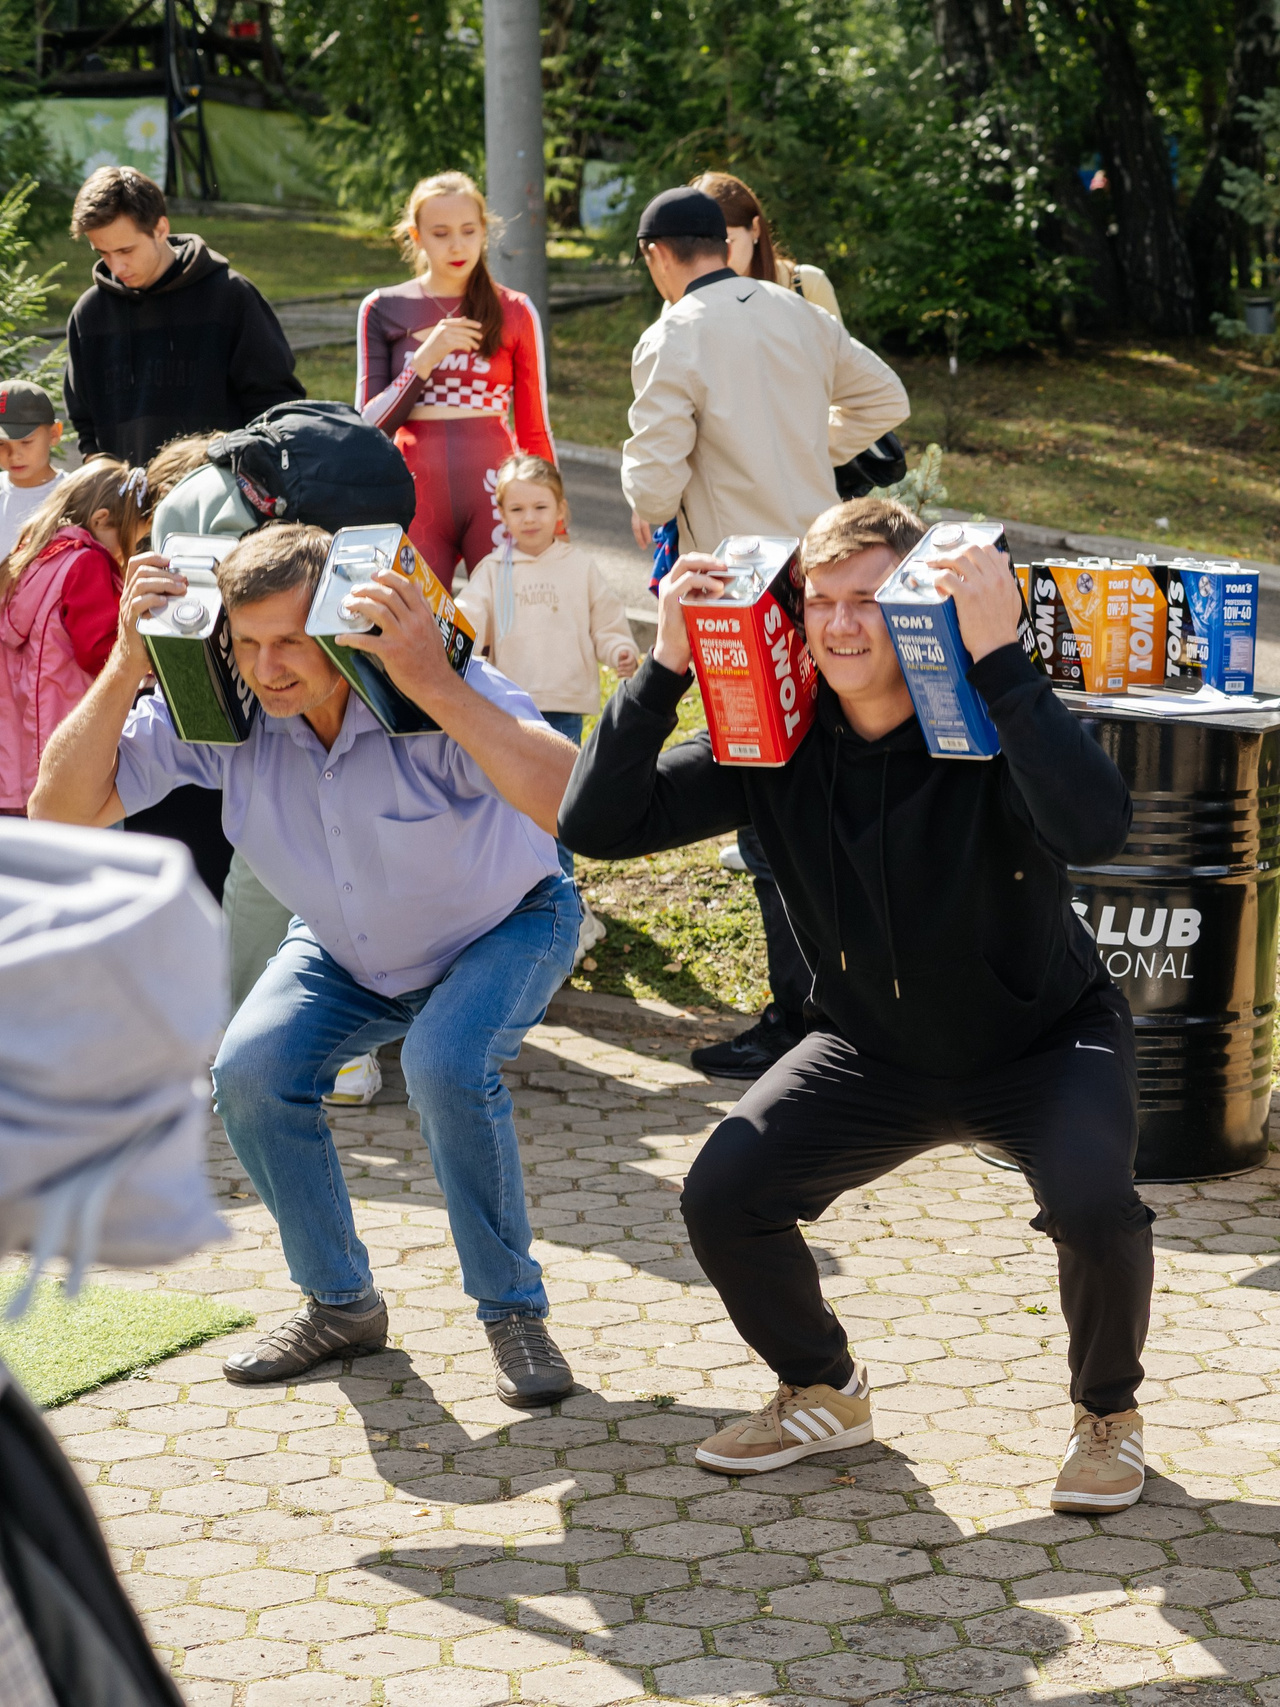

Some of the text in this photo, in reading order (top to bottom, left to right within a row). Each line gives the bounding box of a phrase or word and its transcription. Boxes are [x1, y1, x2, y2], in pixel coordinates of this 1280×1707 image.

[403, 351, 491, 374] TM'S
[1225, 583, 1253, 594] TOM'S
[891, 614, 934, 630] TOM'S
[1223, 606, 1252, 620] 10W-40
[696, 618, 741, 633] TOM'S
[1128, 577, 1156, 673] TOM'S
[1166, 580, 1185, 678] TOM'S
[701, 648, 749, 668] 5W-30
[898, 644, 945, 664] 10W-40
[1061, 641, 1092, 658] 0W-20
[764, 603, 801, 739] TOM'S
[1100, 951, 1194, 979] ONAL
